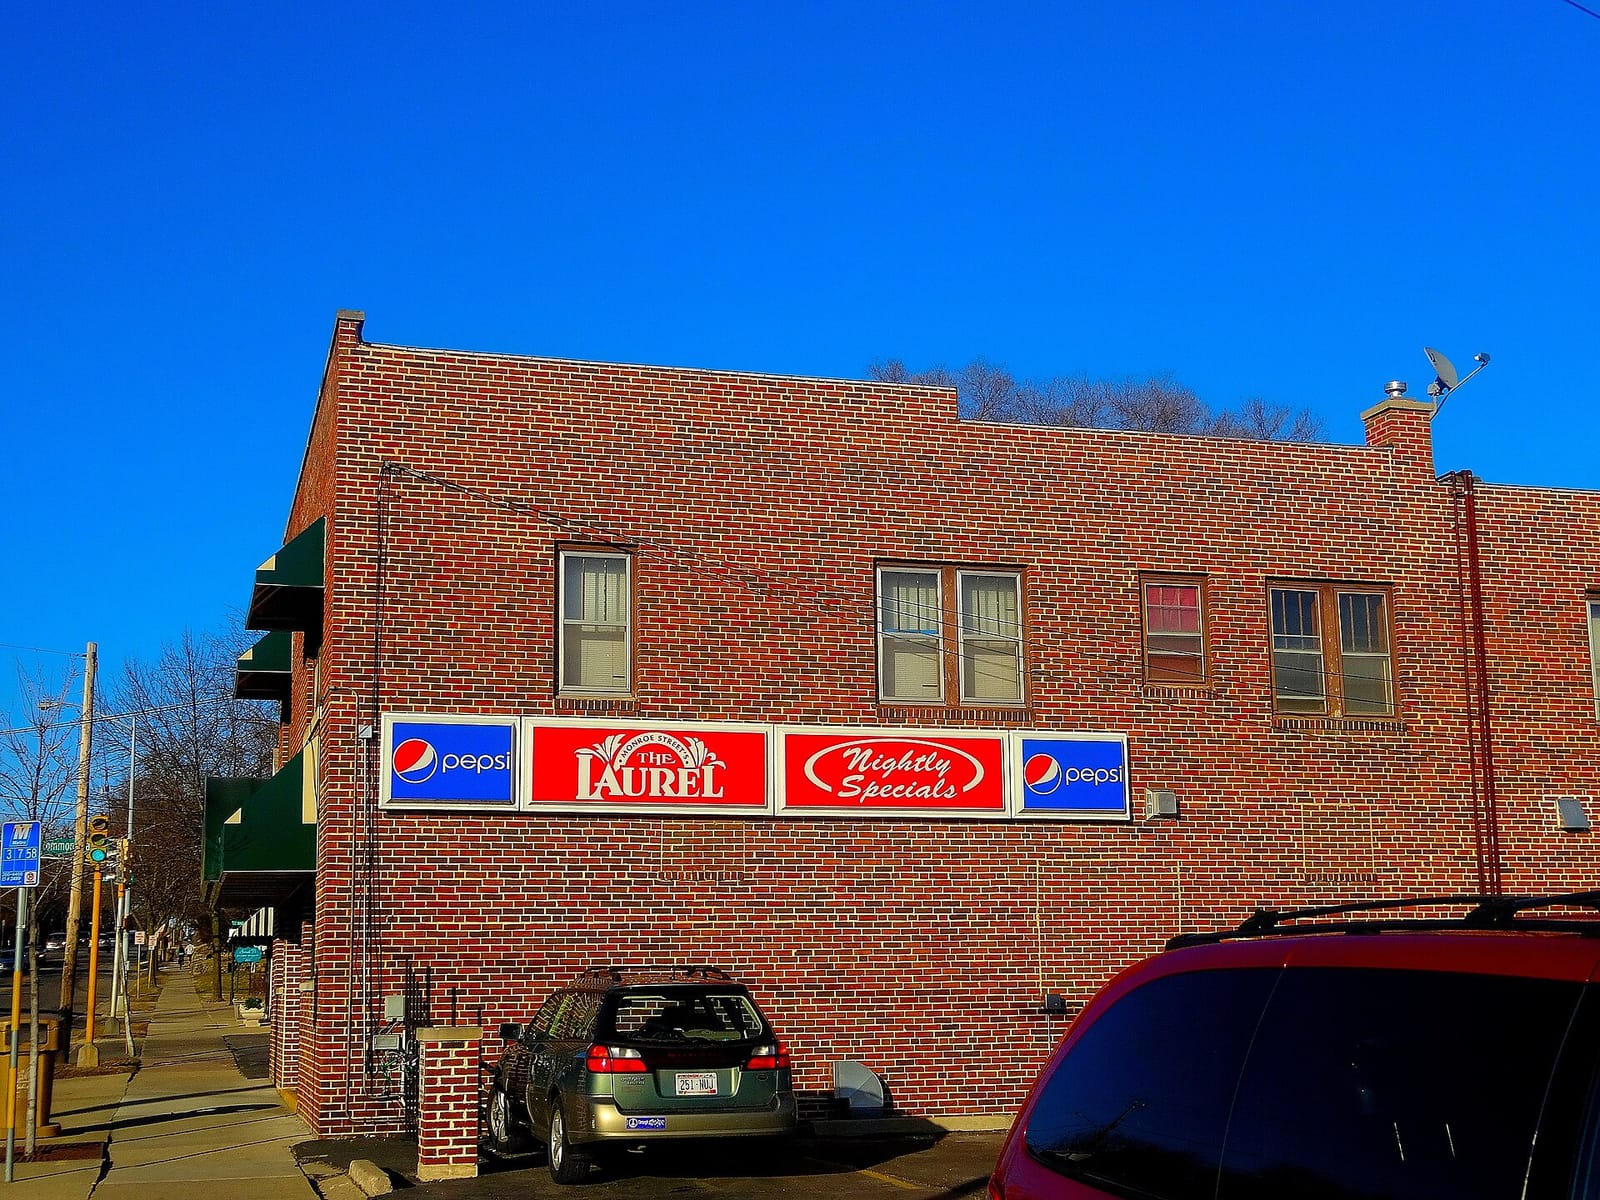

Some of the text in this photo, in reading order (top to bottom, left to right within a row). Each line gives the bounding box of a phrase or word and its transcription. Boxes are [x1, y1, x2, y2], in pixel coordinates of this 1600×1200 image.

[621, 735, 689, 760] MONROE STREET'S
[636, 751, 676, 766] THE
[442, 751, 511, 775] pepsi
[843, 747, 951, 779] Nightly
[575, 754, 724, 800] LAUREL
[1066, 765, 1123, 786] pepsi
[837, 774, 958, 804] Specials
[6, 848, 37, 860] 3 7 58
